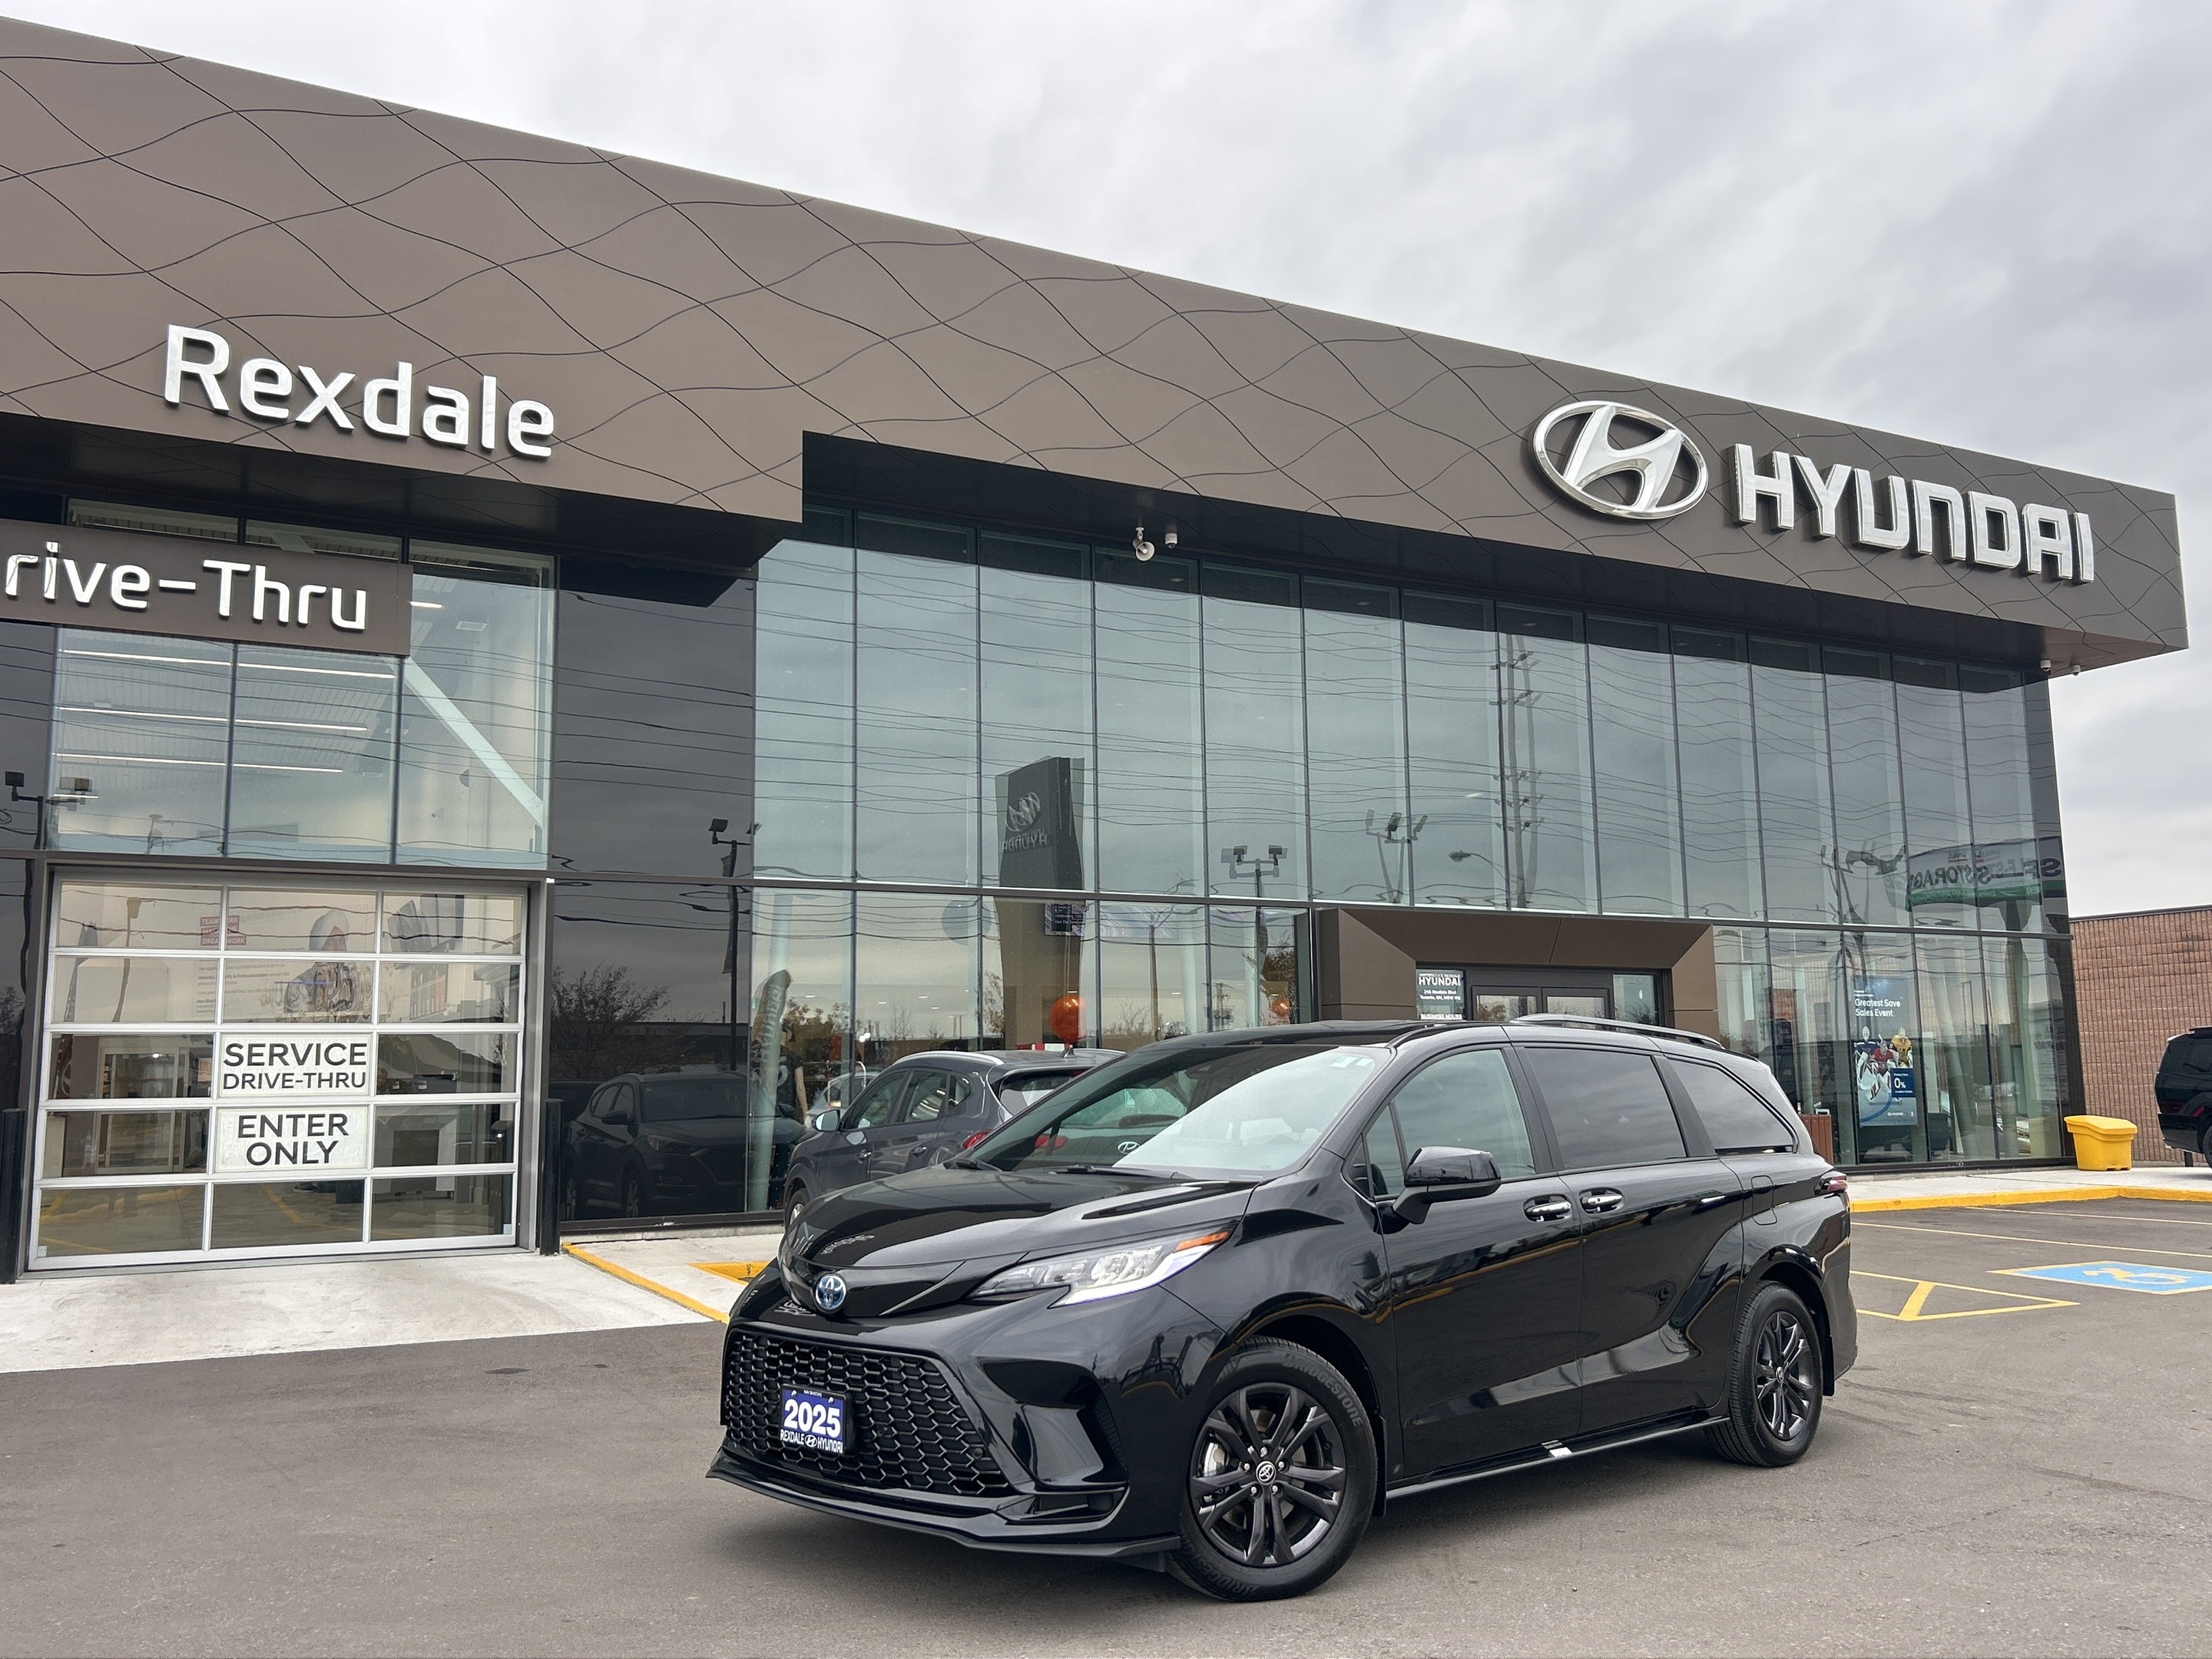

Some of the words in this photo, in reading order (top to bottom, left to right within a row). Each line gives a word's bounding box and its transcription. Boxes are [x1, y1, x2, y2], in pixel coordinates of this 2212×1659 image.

[164, 324, 555, 459] Rexdale
[1727, 442, 2095, 584] HYUNDAI
[3, 541, 369, 632] rive-Thru
[1419, 976, 1461, 986] HYUNDAI
[1854, 998, 1884, 1007] Greatest
[1855, 1008, 1874, 1017] Sales
[1874, 1008, 1893, 1017] Event
[223, 1042, 368, 1067] SERVICE
[223, 1071, 367, 1091] DRIVE-THRU
[1894, 1078, 1906, 1088] 0%
[237, 1113, 349, 1139] ENTER
[246, 1140, 339, 1166] ONLY
[1283, 1353, 1363, 1427] BRIDGESTONE
[783, 1399, 841, 1439] 2025
[780, 1429, 805, 1445] REXDALE
[816, 1436, 843, 1454] HYUNDAI
